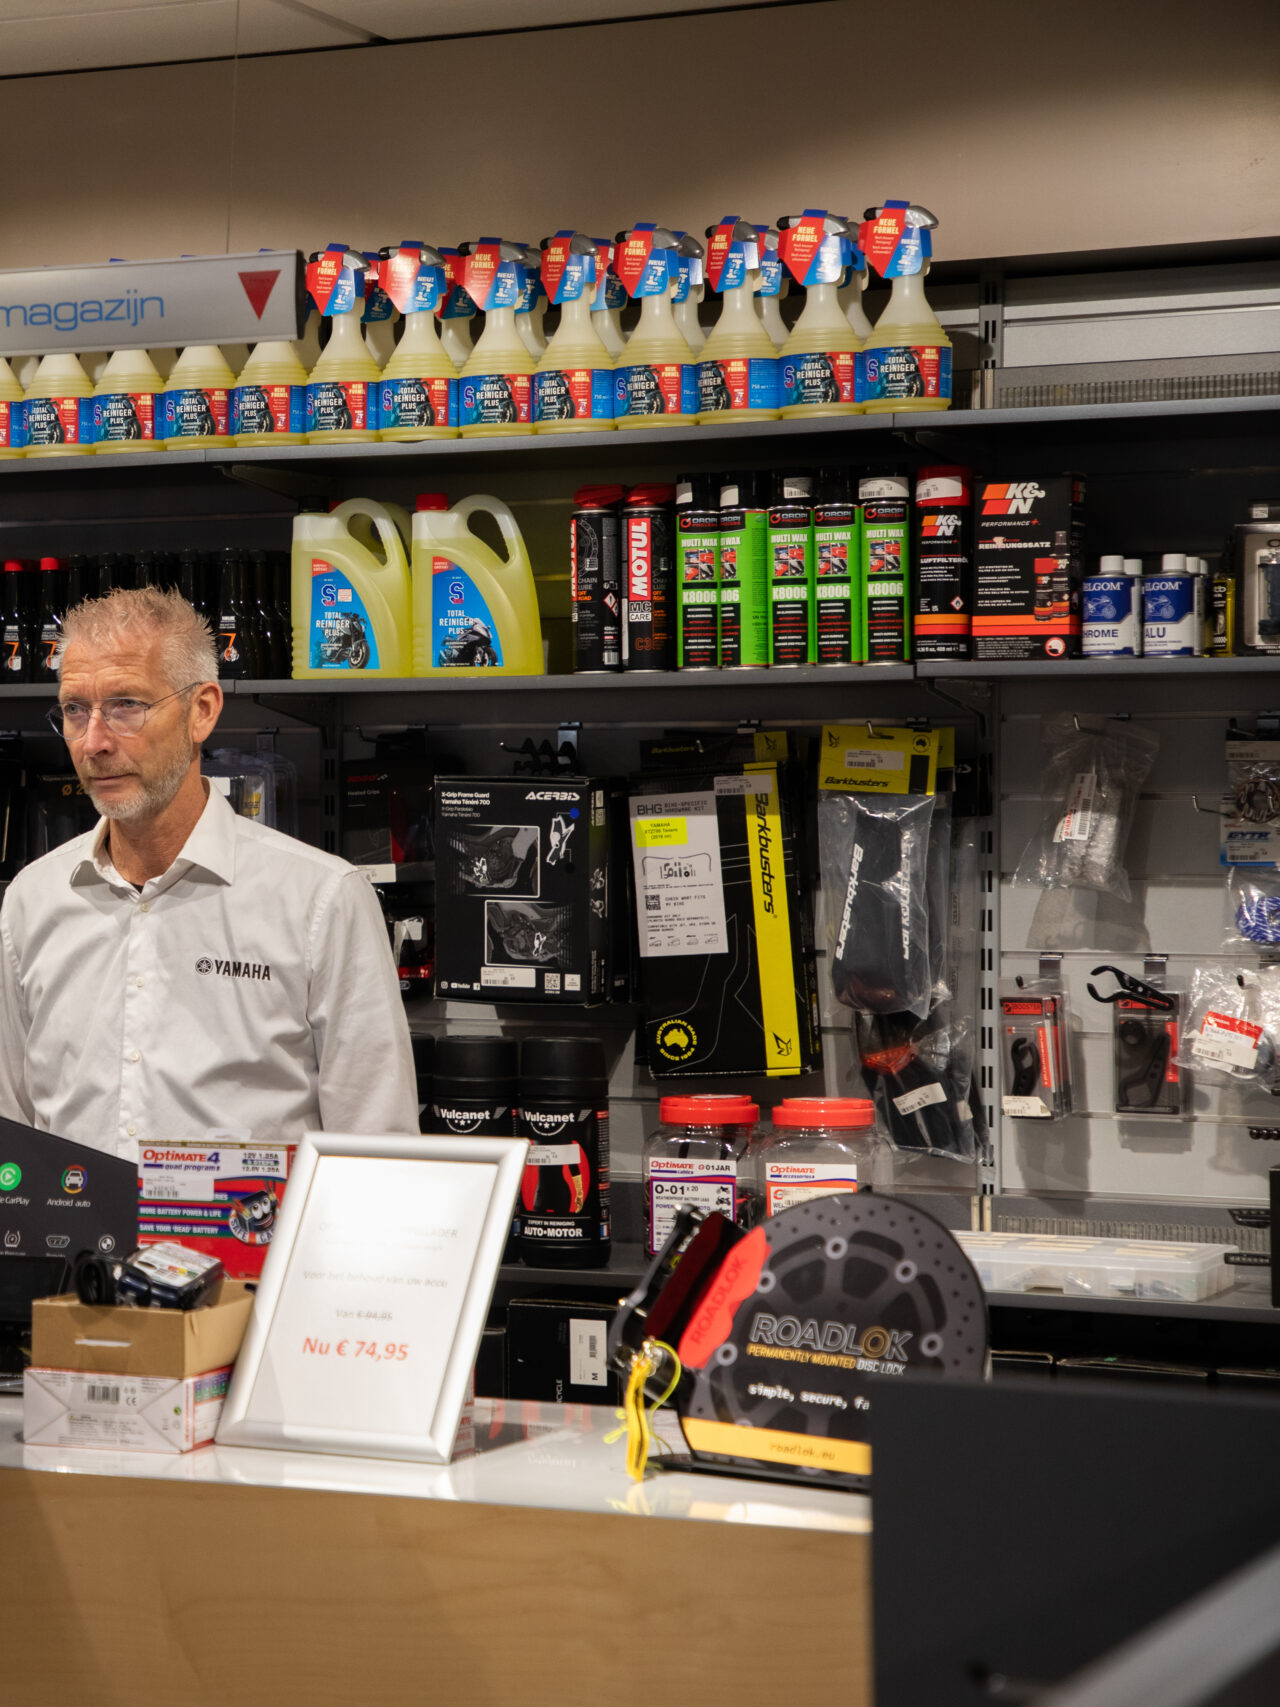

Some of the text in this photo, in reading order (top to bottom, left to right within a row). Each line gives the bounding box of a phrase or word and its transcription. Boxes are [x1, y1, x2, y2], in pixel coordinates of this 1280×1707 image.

[879, 219, 896, 227] NEUE
[798, 226, 815, 235] NEUE
[873, 226, 899, 234] FORMEL
[792, 233, 818, 242] FORMEL
[629, 240, 644, 248] NEUE
[624, 247, 646, 256] FORMEL
[797, 369, 830, 378] REINIGER
[880, 364, 915, 373] REINIGER
[627, 382, 655, 390] REINIGER
[981, 520, 1030, 528] PERFORMANCE
[771, 533, 808, 543] MULTI WAX
[815, 531, 851, 541] MULTI WAX
[866, 529, 904, 538] MULTI WAX
[681, 538, 718, 547] MULTI WAX
[725, 537, 741, 545] WAX
[631, 522, 648, 597] MOTUL
[772, 587, 807, 600] K8006
[816, 585, 850, 598] K8006
[868, 582, 903, 596] K8006
[682, 590, 717, 603] K8006
[630, 602, 651, 612] MC
[324, 611, 342, 619] TOTAL
[315, 619, 350, 628] REINIGER
[439, 617, 473, 626] REINIGER
[324, 628, 341, 636] PLUS
[1082, 629, 1119, 638] HROME
[1144, 627, 1167, 638] ALU
[824, 776, 890, 788] Barkbusters
[525, 791, 580, 801] ACERBIS
[637, 804, 663, 816] BHG
[755, 793, 774, 914] Barkbusters
[836, 843, 863, 960] Barkbusters
[214, 959, 271, 981] YAMAHA
[440, 1108, 490, 1119] Vulcanet
[525, 1111, 575, 1122] Vulcanet
[5, 1196, 30, 1206] CarPlay
[46, 1198, 91, 1208] Android auto
[140, 1207, 156, 1215] MORE
[157, 1208, 182, 1216] BATTERY
[183, 1209, 202, 1217] POWER
[209, 1210, 222, 1218] LIFE
[140, 1224, 155, 1232] SAVE
[192, 1227, 219, 1235] BATTERY
[690, 1255, 748, 1345] ROADLOK
[749, 1312, 913, 1363] ROADLOK
[302, 1337, 409, 1362] Nu € 74,95
[747, 1343, 906, 1376] PERMANENTLY MOUNTED DISC LOCK
[591, 1372, 598, 1381] M
[748, 1382, 870, 1411] simple, secure, fa
[770, 1441, 836, 1461] roadlok.eu
